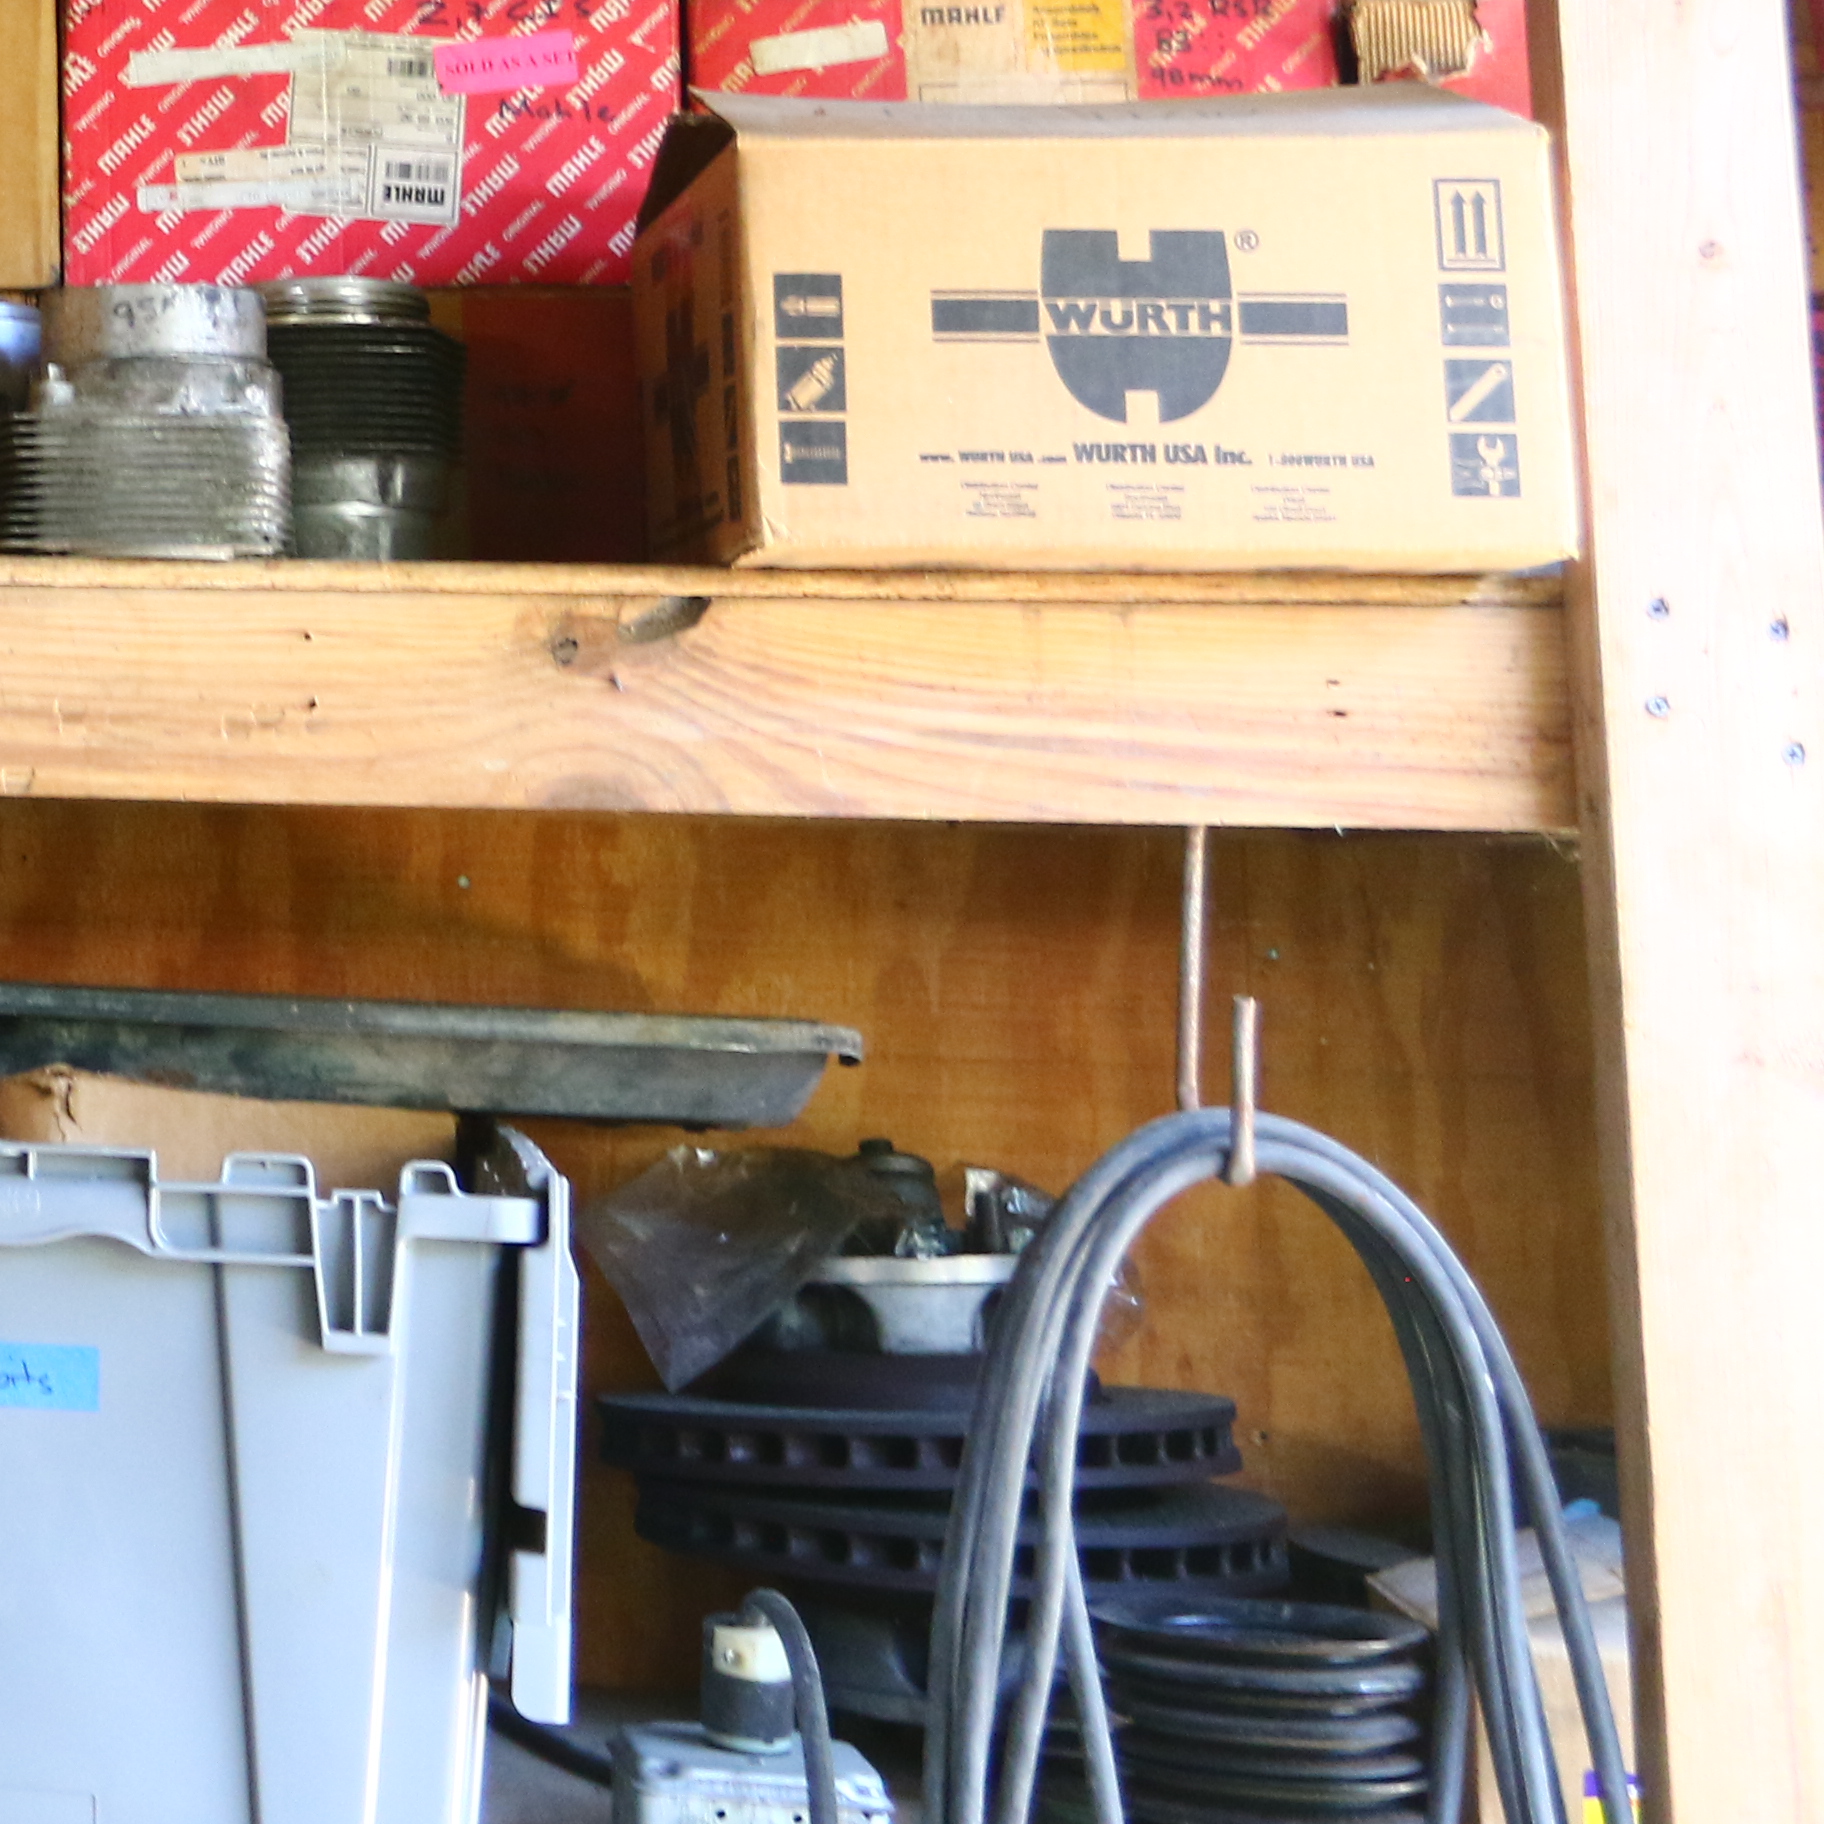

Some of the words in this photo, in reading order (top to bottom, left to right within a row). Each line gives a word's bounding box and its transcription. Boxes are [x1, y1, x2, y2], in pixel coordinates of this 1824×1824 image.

[446, 58, 495, 75] SOLD
[501, 56, 521, 72] AS
[526, 55, 539, 69] A
[565, 47, 626, 111] MAHLE
[177, 85, 236, 146] MAHLE
[607, 92, 650, 136] ORIGINAL
[98, 113, 157, 175] MAHLE
[545, 133, 606, 199] MAHLE
[383, 185, 445, 204] MAHLE
[462, 152, 520, 217] MAHLE
[583, 167, 628, 212] ORIGINAL
[72, 192, 131, 254] MAHLE
[503, 199, 546, 242] ORIGINAL
[521, 213, 583, 275] MAHLE
[1044, 301, 1231, 335] WURTH
[1073, 441, 1157, 465] WURTH
[1164, 442, 1208, 465] USA
[1214, 443, 1253, 466] Inc.
